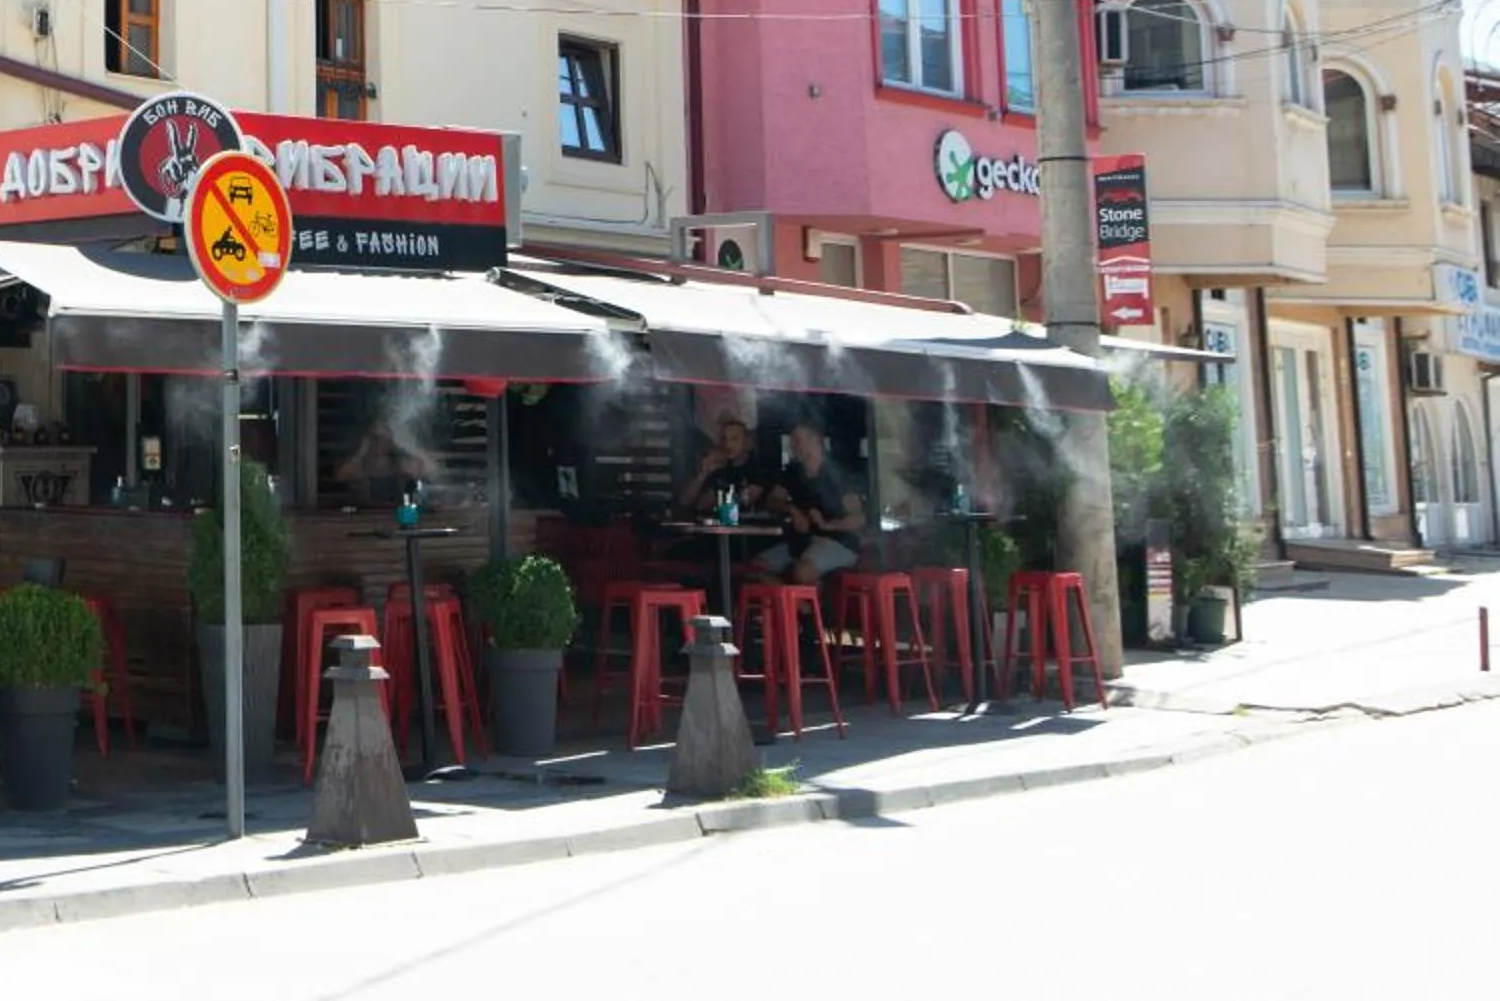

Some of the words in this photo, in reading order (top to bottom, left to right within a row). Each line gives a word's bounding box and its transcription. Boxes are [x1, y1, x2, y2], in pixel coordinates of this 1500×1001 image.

[1099, 207, 1143, 222] Stone
[1100, 223, 1145, 242] Bridge
[336, 234, 349, 253] &
